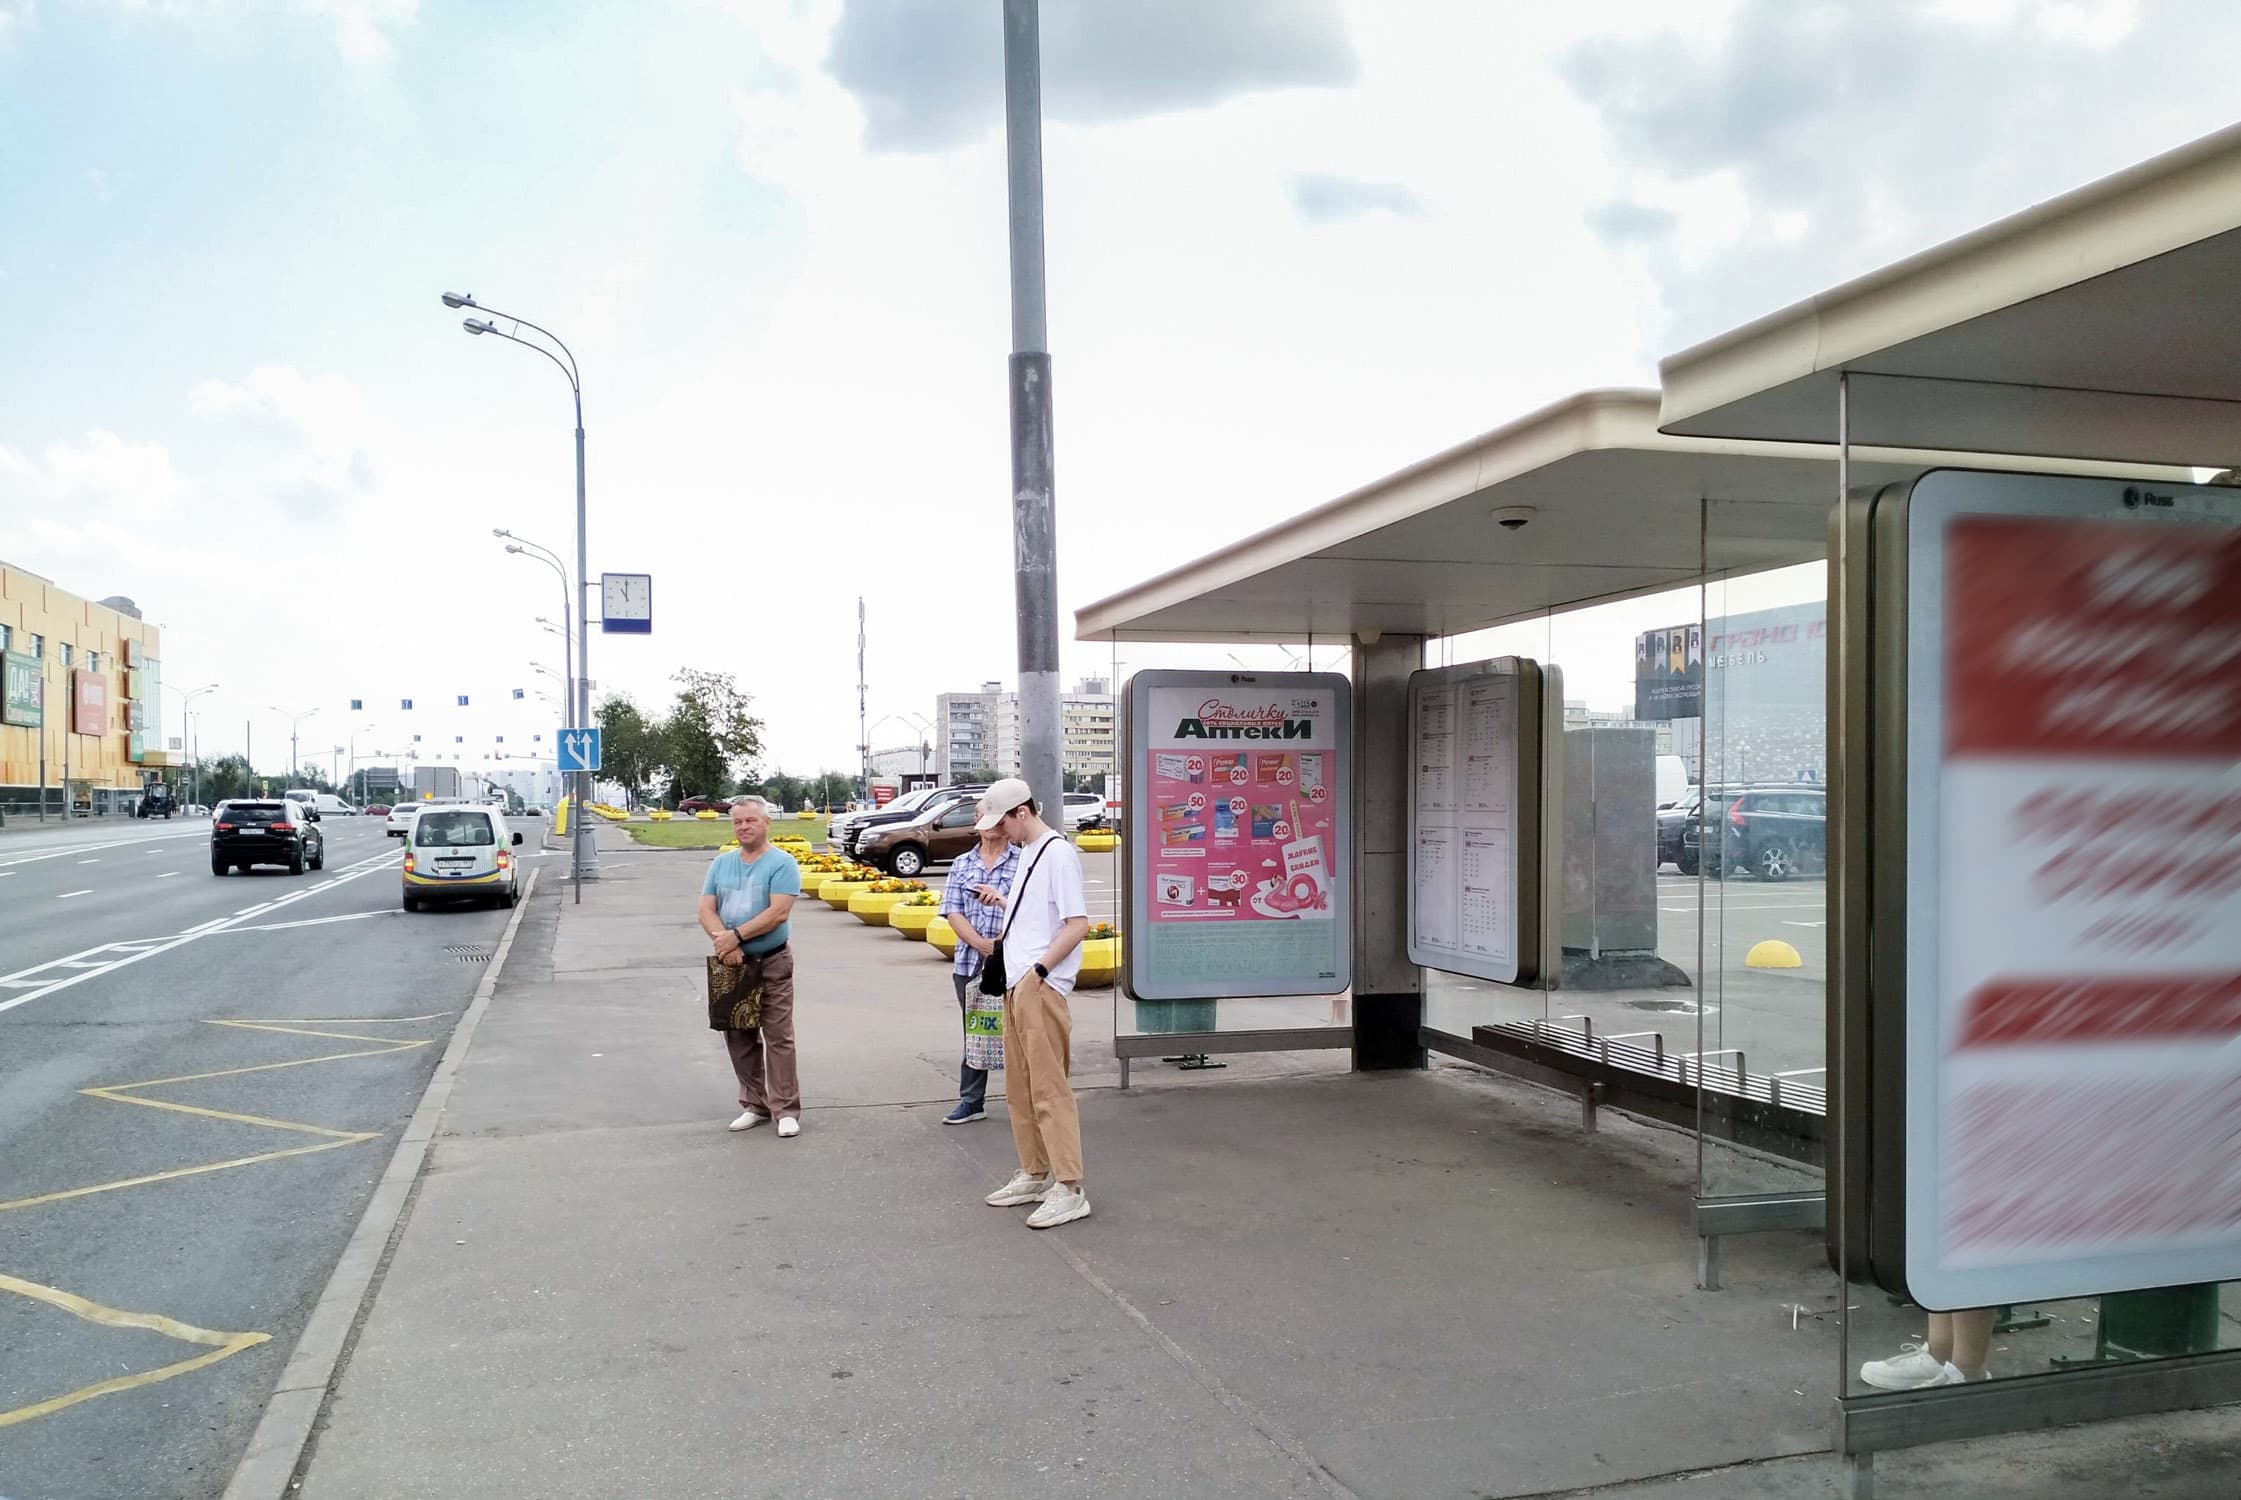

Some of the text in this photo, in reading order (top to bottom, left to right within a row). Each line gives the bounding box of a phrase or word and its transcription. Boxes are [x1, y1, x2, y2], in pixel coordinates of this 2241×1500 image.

[2144, 491, 2175, 507] Russ
[1708, 651, 1766, 669] МЕБЕЛЬ
[1187, 760, 1202, 770] 20
[1232, 770, 1247, 781] 20
[1278, 771, 1293, 781] 20
[1311, 789, 1326, 799] 20
[1190, 797, 1204, 807] 50
[1231, 801, 1246, 810] 20
[1274, 825, 1289, 835] 20
[1232, 874, 1246, 884] 30
